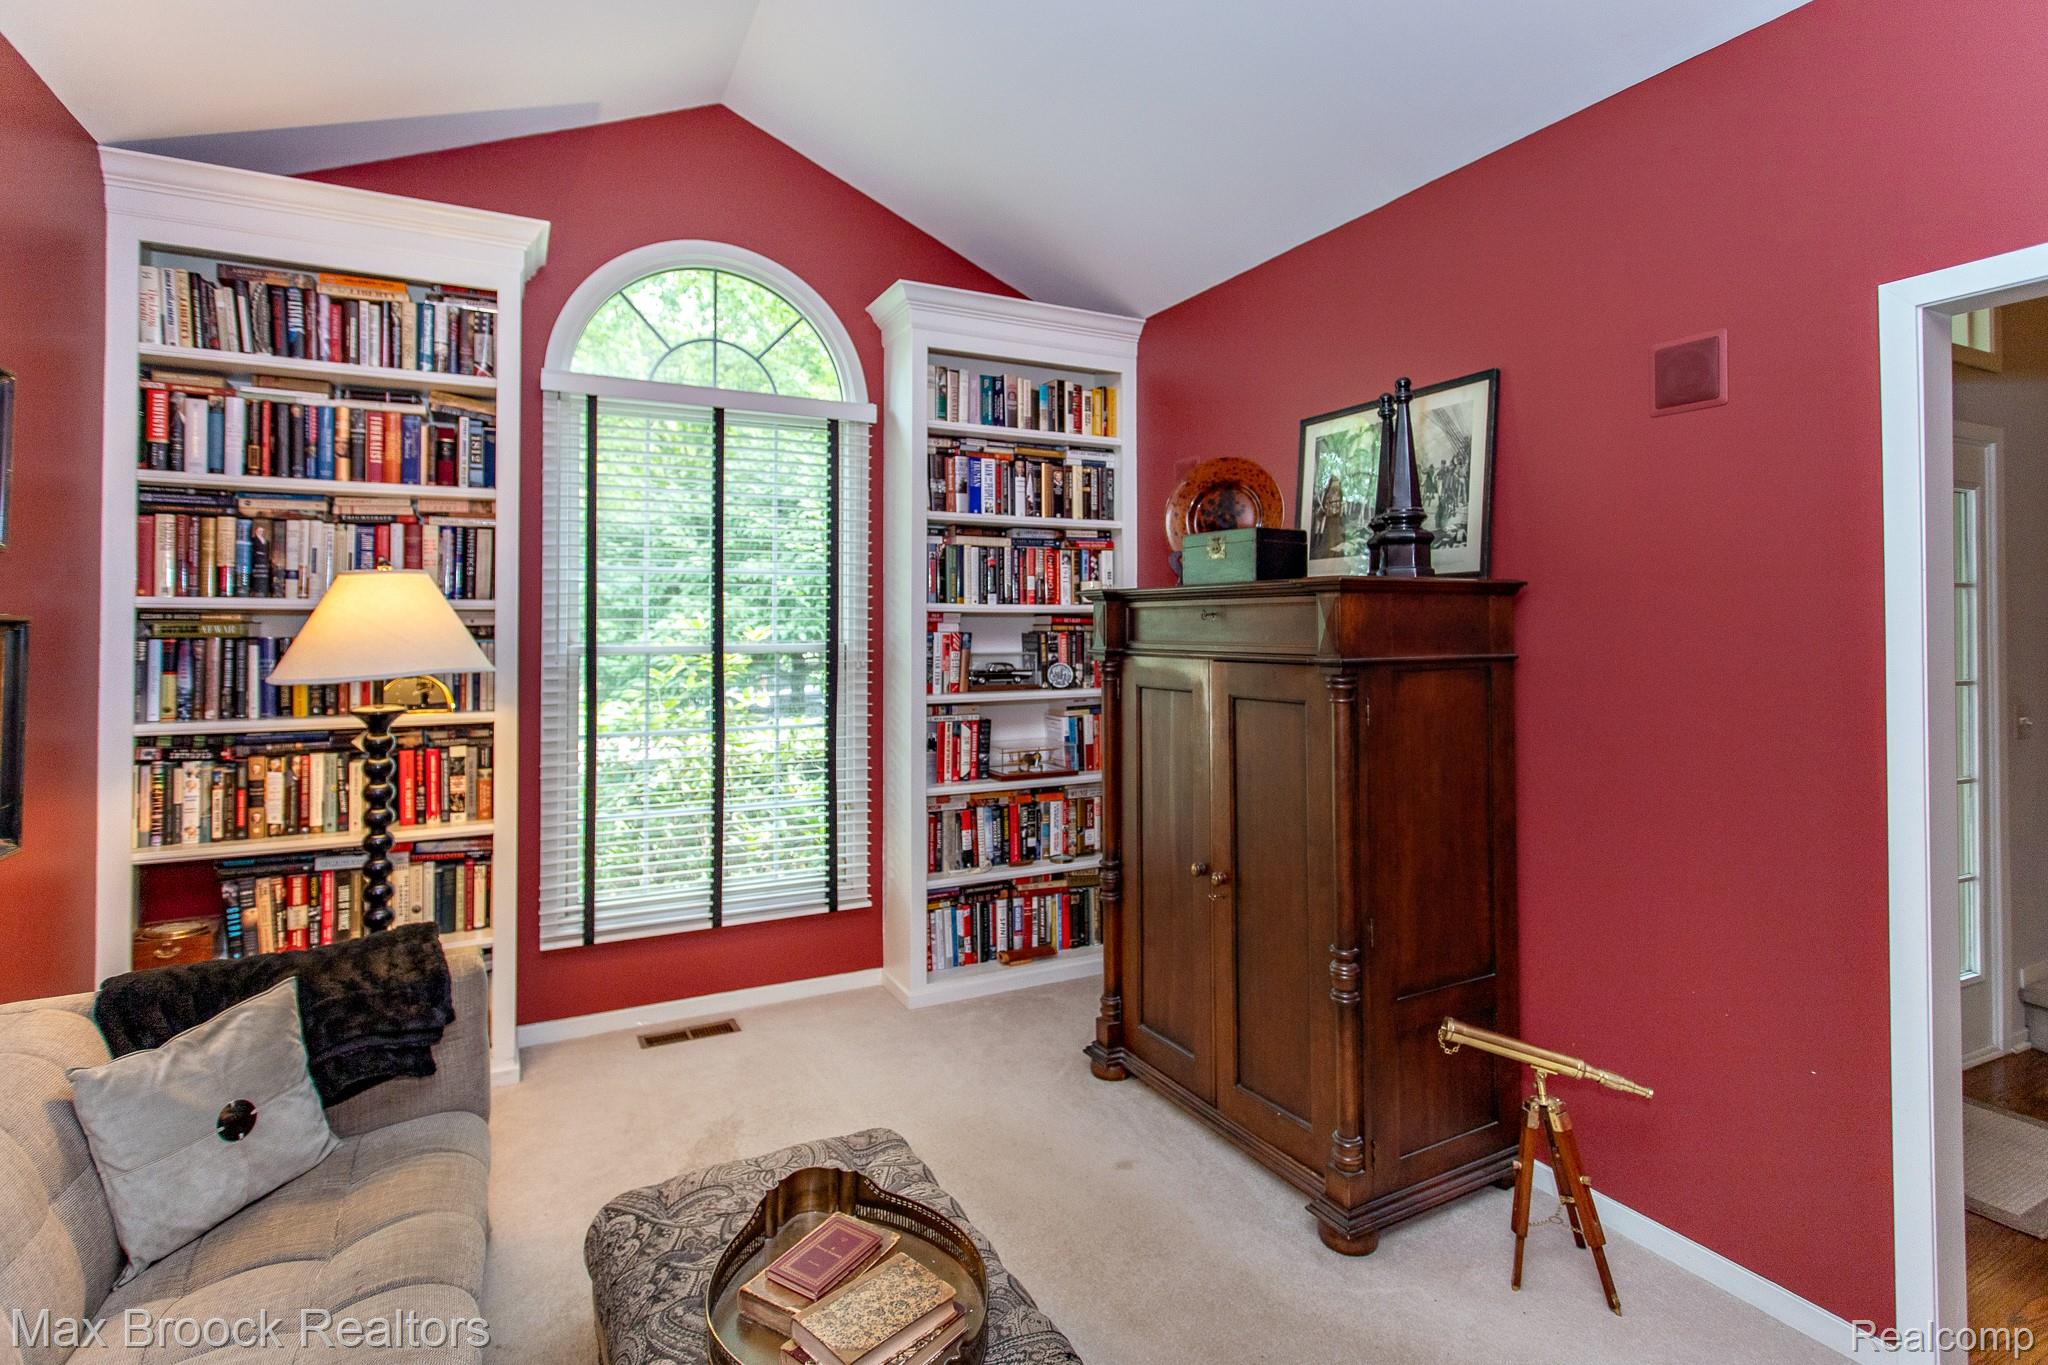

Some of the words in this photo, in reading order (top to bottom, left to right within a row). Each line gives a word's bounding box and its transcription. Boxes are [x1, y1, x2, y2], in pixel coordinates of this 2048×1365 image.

[152, 393, 168, 437] WASHINGTON
[471, 436, 481, 463] 1812
[1047, 556, 1055, 589] INFERNO
